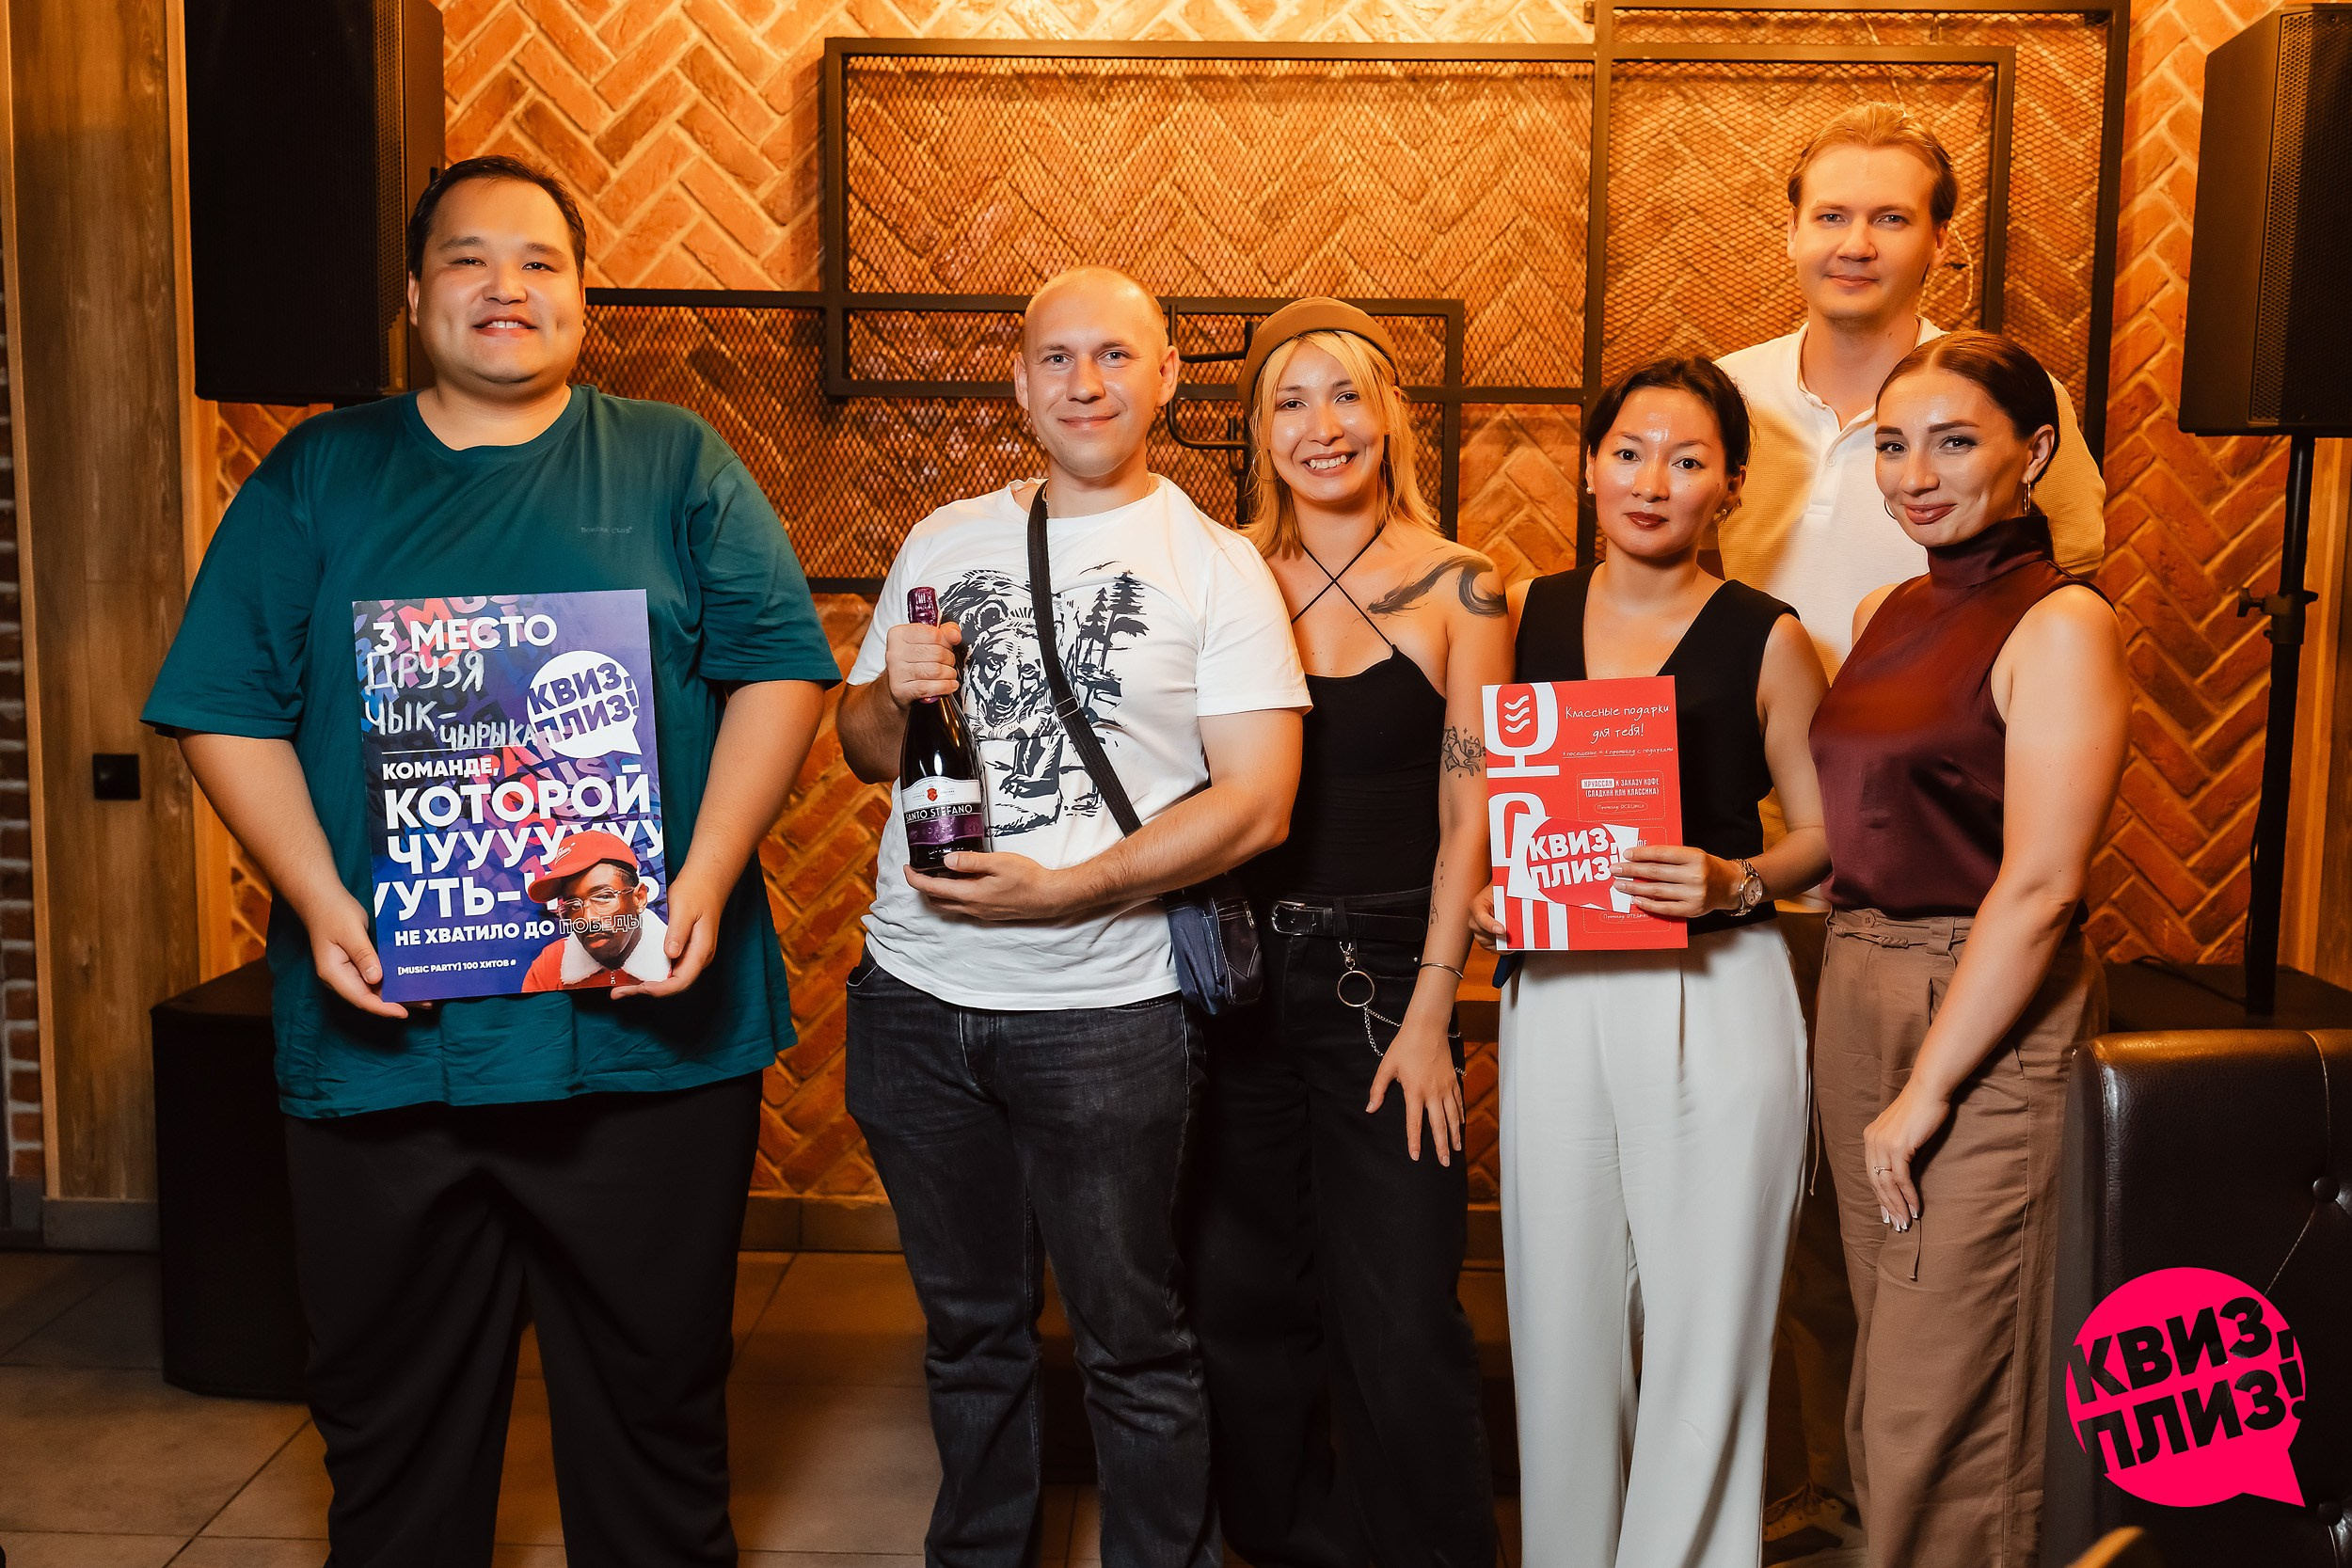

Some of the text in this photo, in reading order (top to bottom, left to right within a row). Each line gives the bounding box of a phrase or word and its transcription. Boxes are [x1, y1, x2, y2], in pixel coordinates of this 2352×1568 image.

[373, 614, 558, 654] 3 МЕСТО
[365, 650, 485, 696] ДРУЗЯ
[529, 662, 632, 715] КВИЗ,
[534, 689, 639, 744] ПЛИЗ!
[1565, 705, 1669, 721] Классные подарки
[1590, 723, 1645, 744] для тебя!
[1643, 747, 1674, 756] подарками
[382, 757, 501, 781] КОМАНДЕ,
[1614, 788, 1626, 797] ИЛИ
[1620, 778, 1644, 787] ЗАКАЗУ
[1644, 777, 1660, 785] КОФЕ
[384, 764, 651, 830] КОТОРОЙ
[905, 804, 973, 823] SANTO STEFANO
[1529, 827, 1617, 862] КВИЗ,
[394, 930, 421, 947] НЕ
[424, 922, 520, 945] ХВАТИЛО
[524, 920, 555, 940] ДО
[397, 965, 430, 976] [MUSIC
[431, 962, 461, 973] PARTY]
[462, 961, 478, 971] 100
[479, 959, 509, 970] ХИТОВ
